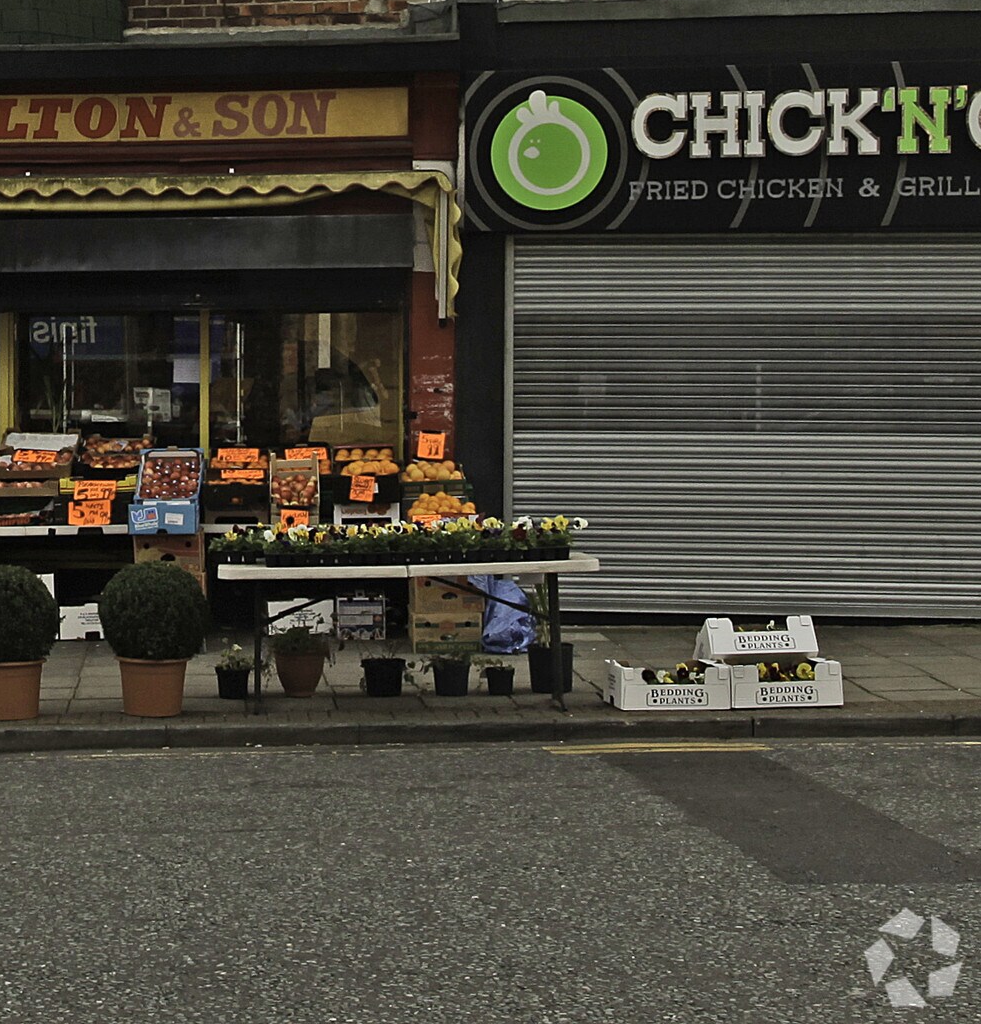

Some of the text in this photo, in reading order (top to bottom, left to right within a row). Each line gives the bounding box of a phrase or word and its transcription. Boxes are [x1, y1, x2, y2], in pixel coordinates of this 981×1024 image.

[172, 106, 202, 138] &
[211, 91, 337, 137] SON
[631, 84, 981, 160] CHICK'N'
[629, 176, 981, 201] FRIED CHICKEN & GRILL
[738, 634, 790, 644] BEDDING
[651, 688, 704, 698] BEDDING
[760, 685, 813, 696] BEDDING
[659, 697, 696, 705] PLANTS
[769, 695, 806, 703] PLANTS
